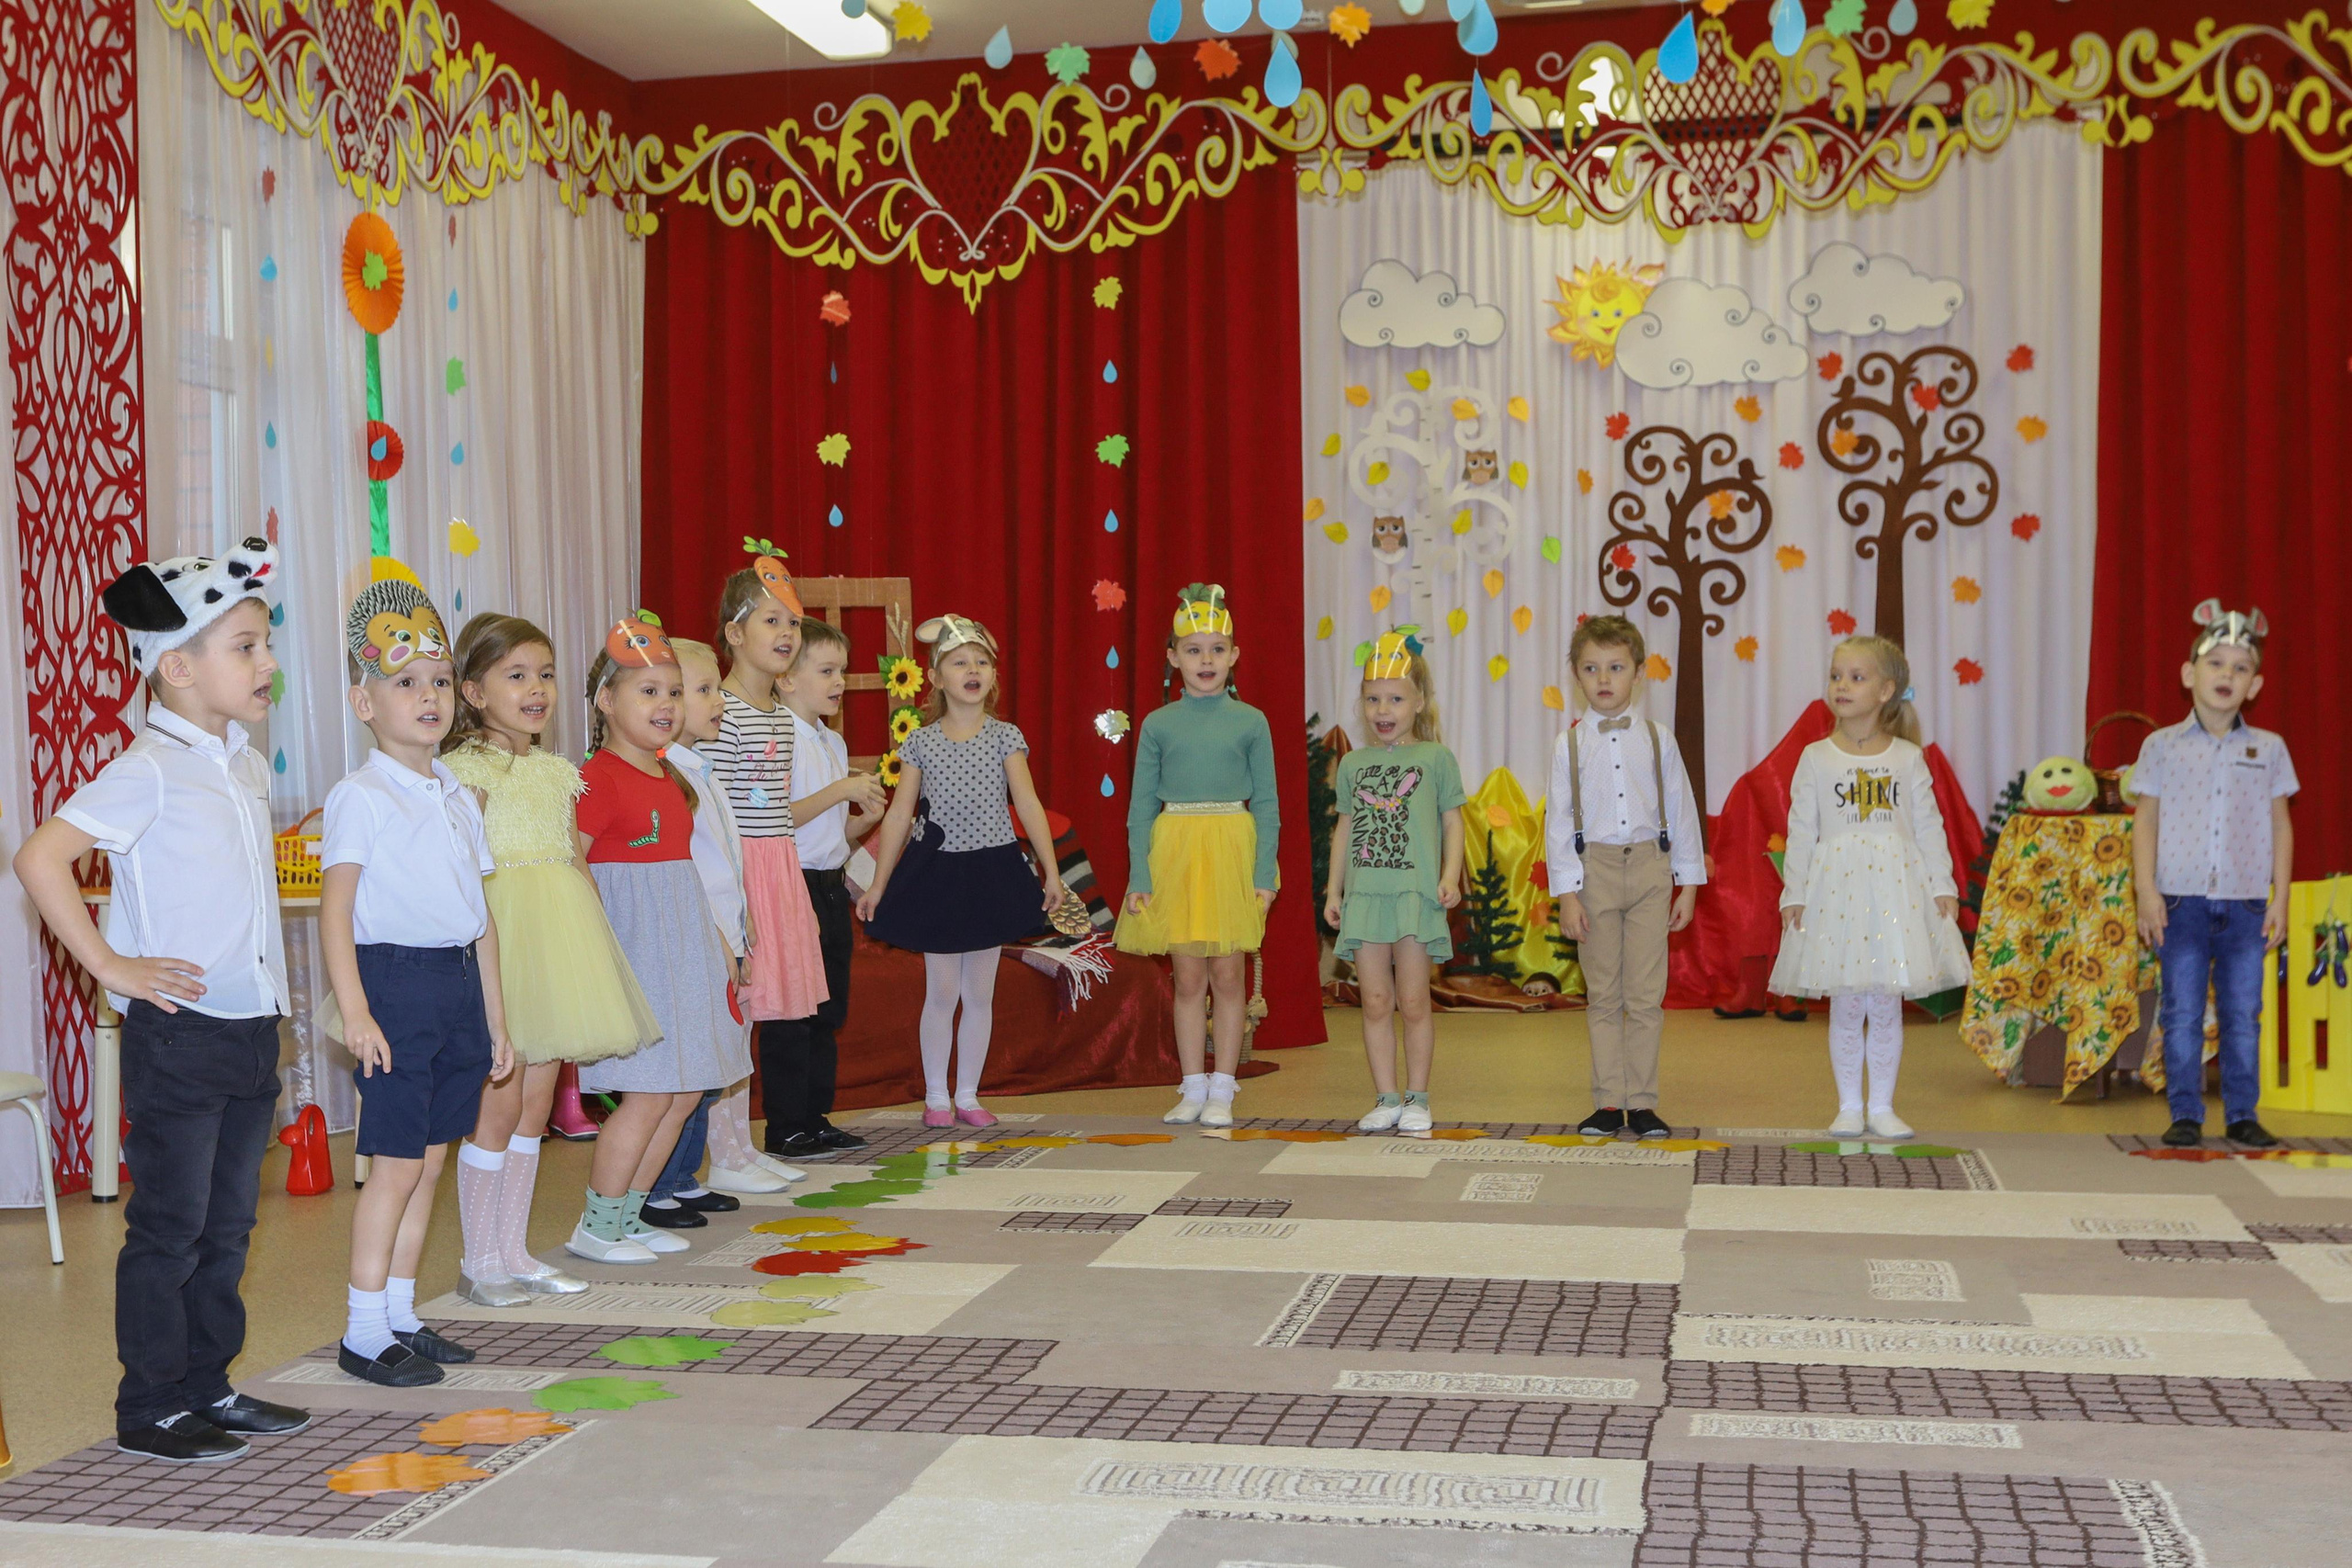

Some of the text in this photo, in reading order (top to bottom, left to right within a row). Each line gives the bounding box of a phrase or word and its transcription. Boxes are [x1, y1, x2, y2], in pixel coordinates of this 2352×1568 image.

[1376, 776, 1389, 793] A
[1834, 781, 1900, 808] SHINE
[1847, 812, 1860, 824] LIK
